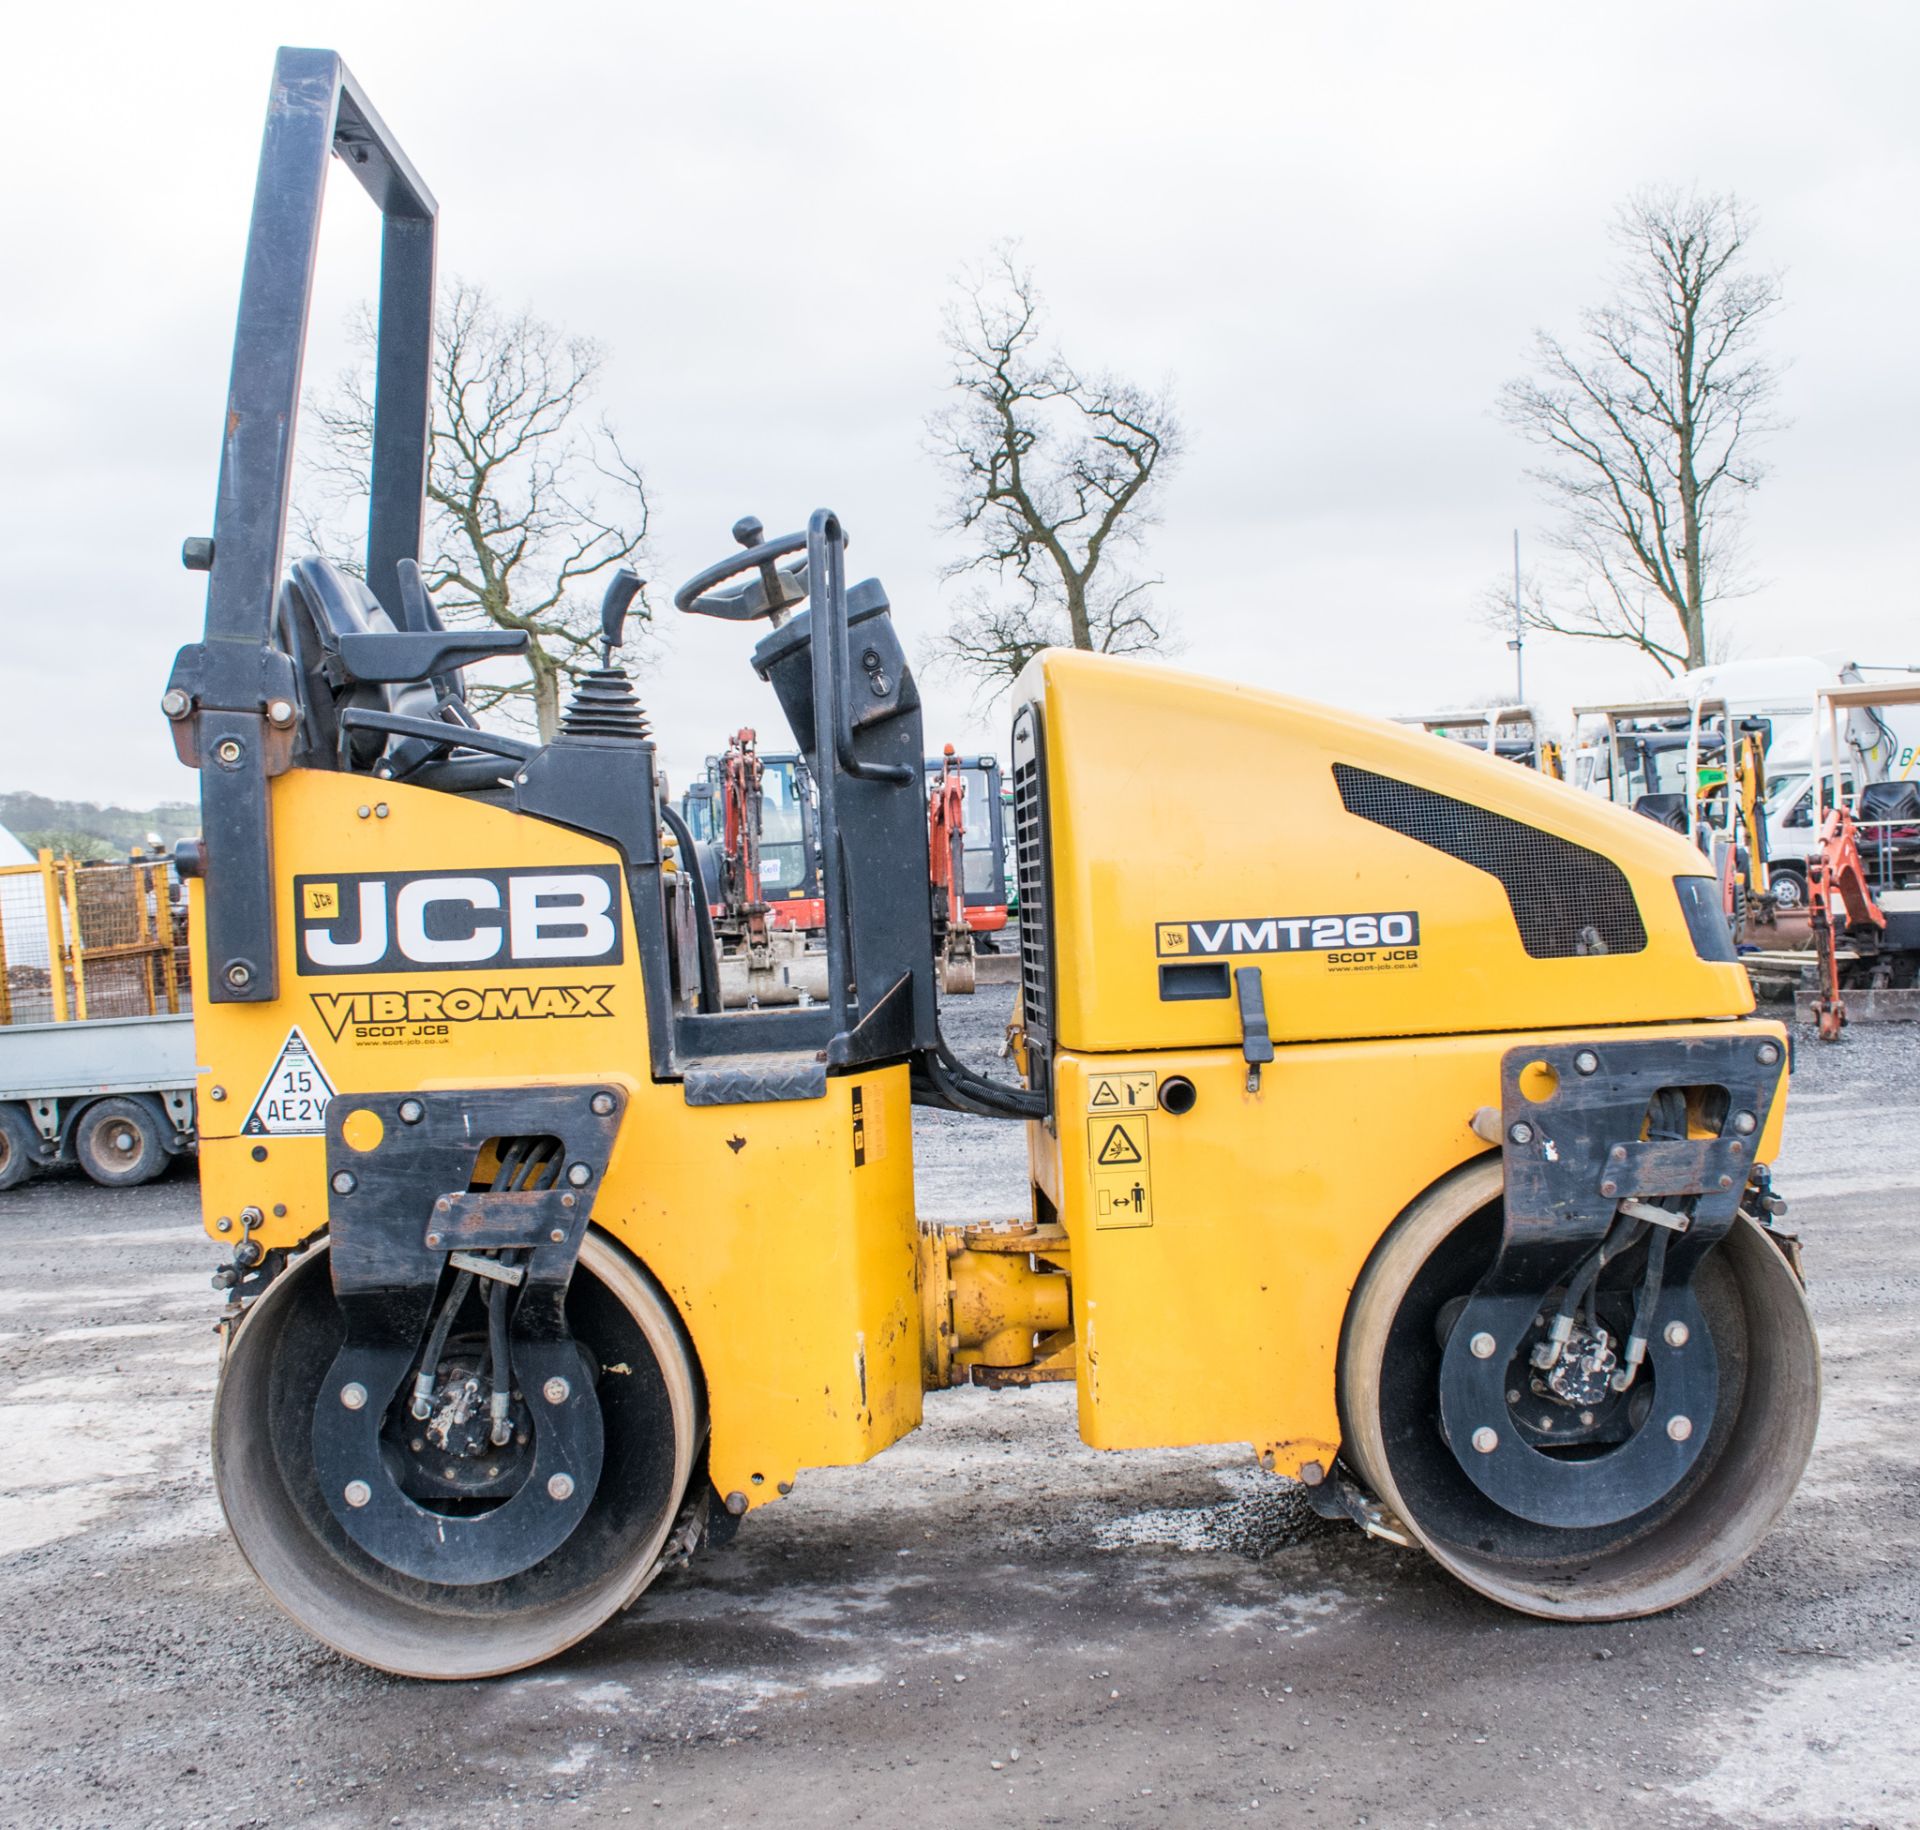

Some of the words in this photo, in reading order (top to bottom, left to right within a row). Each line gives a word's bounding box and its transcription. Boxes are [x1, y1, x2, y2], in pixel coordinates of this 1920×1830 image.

[313, 892, 332, 909] JCB
[305, 874, 616, 966] JCB
[1167, 932, 1184, 946] JCB
[1191, 914, 1413, 952] VMT260
[1327, 952, 1376, 964] SCOT
[1383, 950, 1418, 961] JCB
[1328, 962, 1418, 972] www.scot-jcb.co.uk
[309, 985, 616, 1042] VIBROMAX
[355, 1026, 406, 1037] SCOT
[412, 1025, 449, 1036] JCB
[356, 1037, 449, 1047] www.scot-jcb.co.uk
[283, 1071, 312, 1093] 15
[267, 1098, 327, 1121] AE2Y
